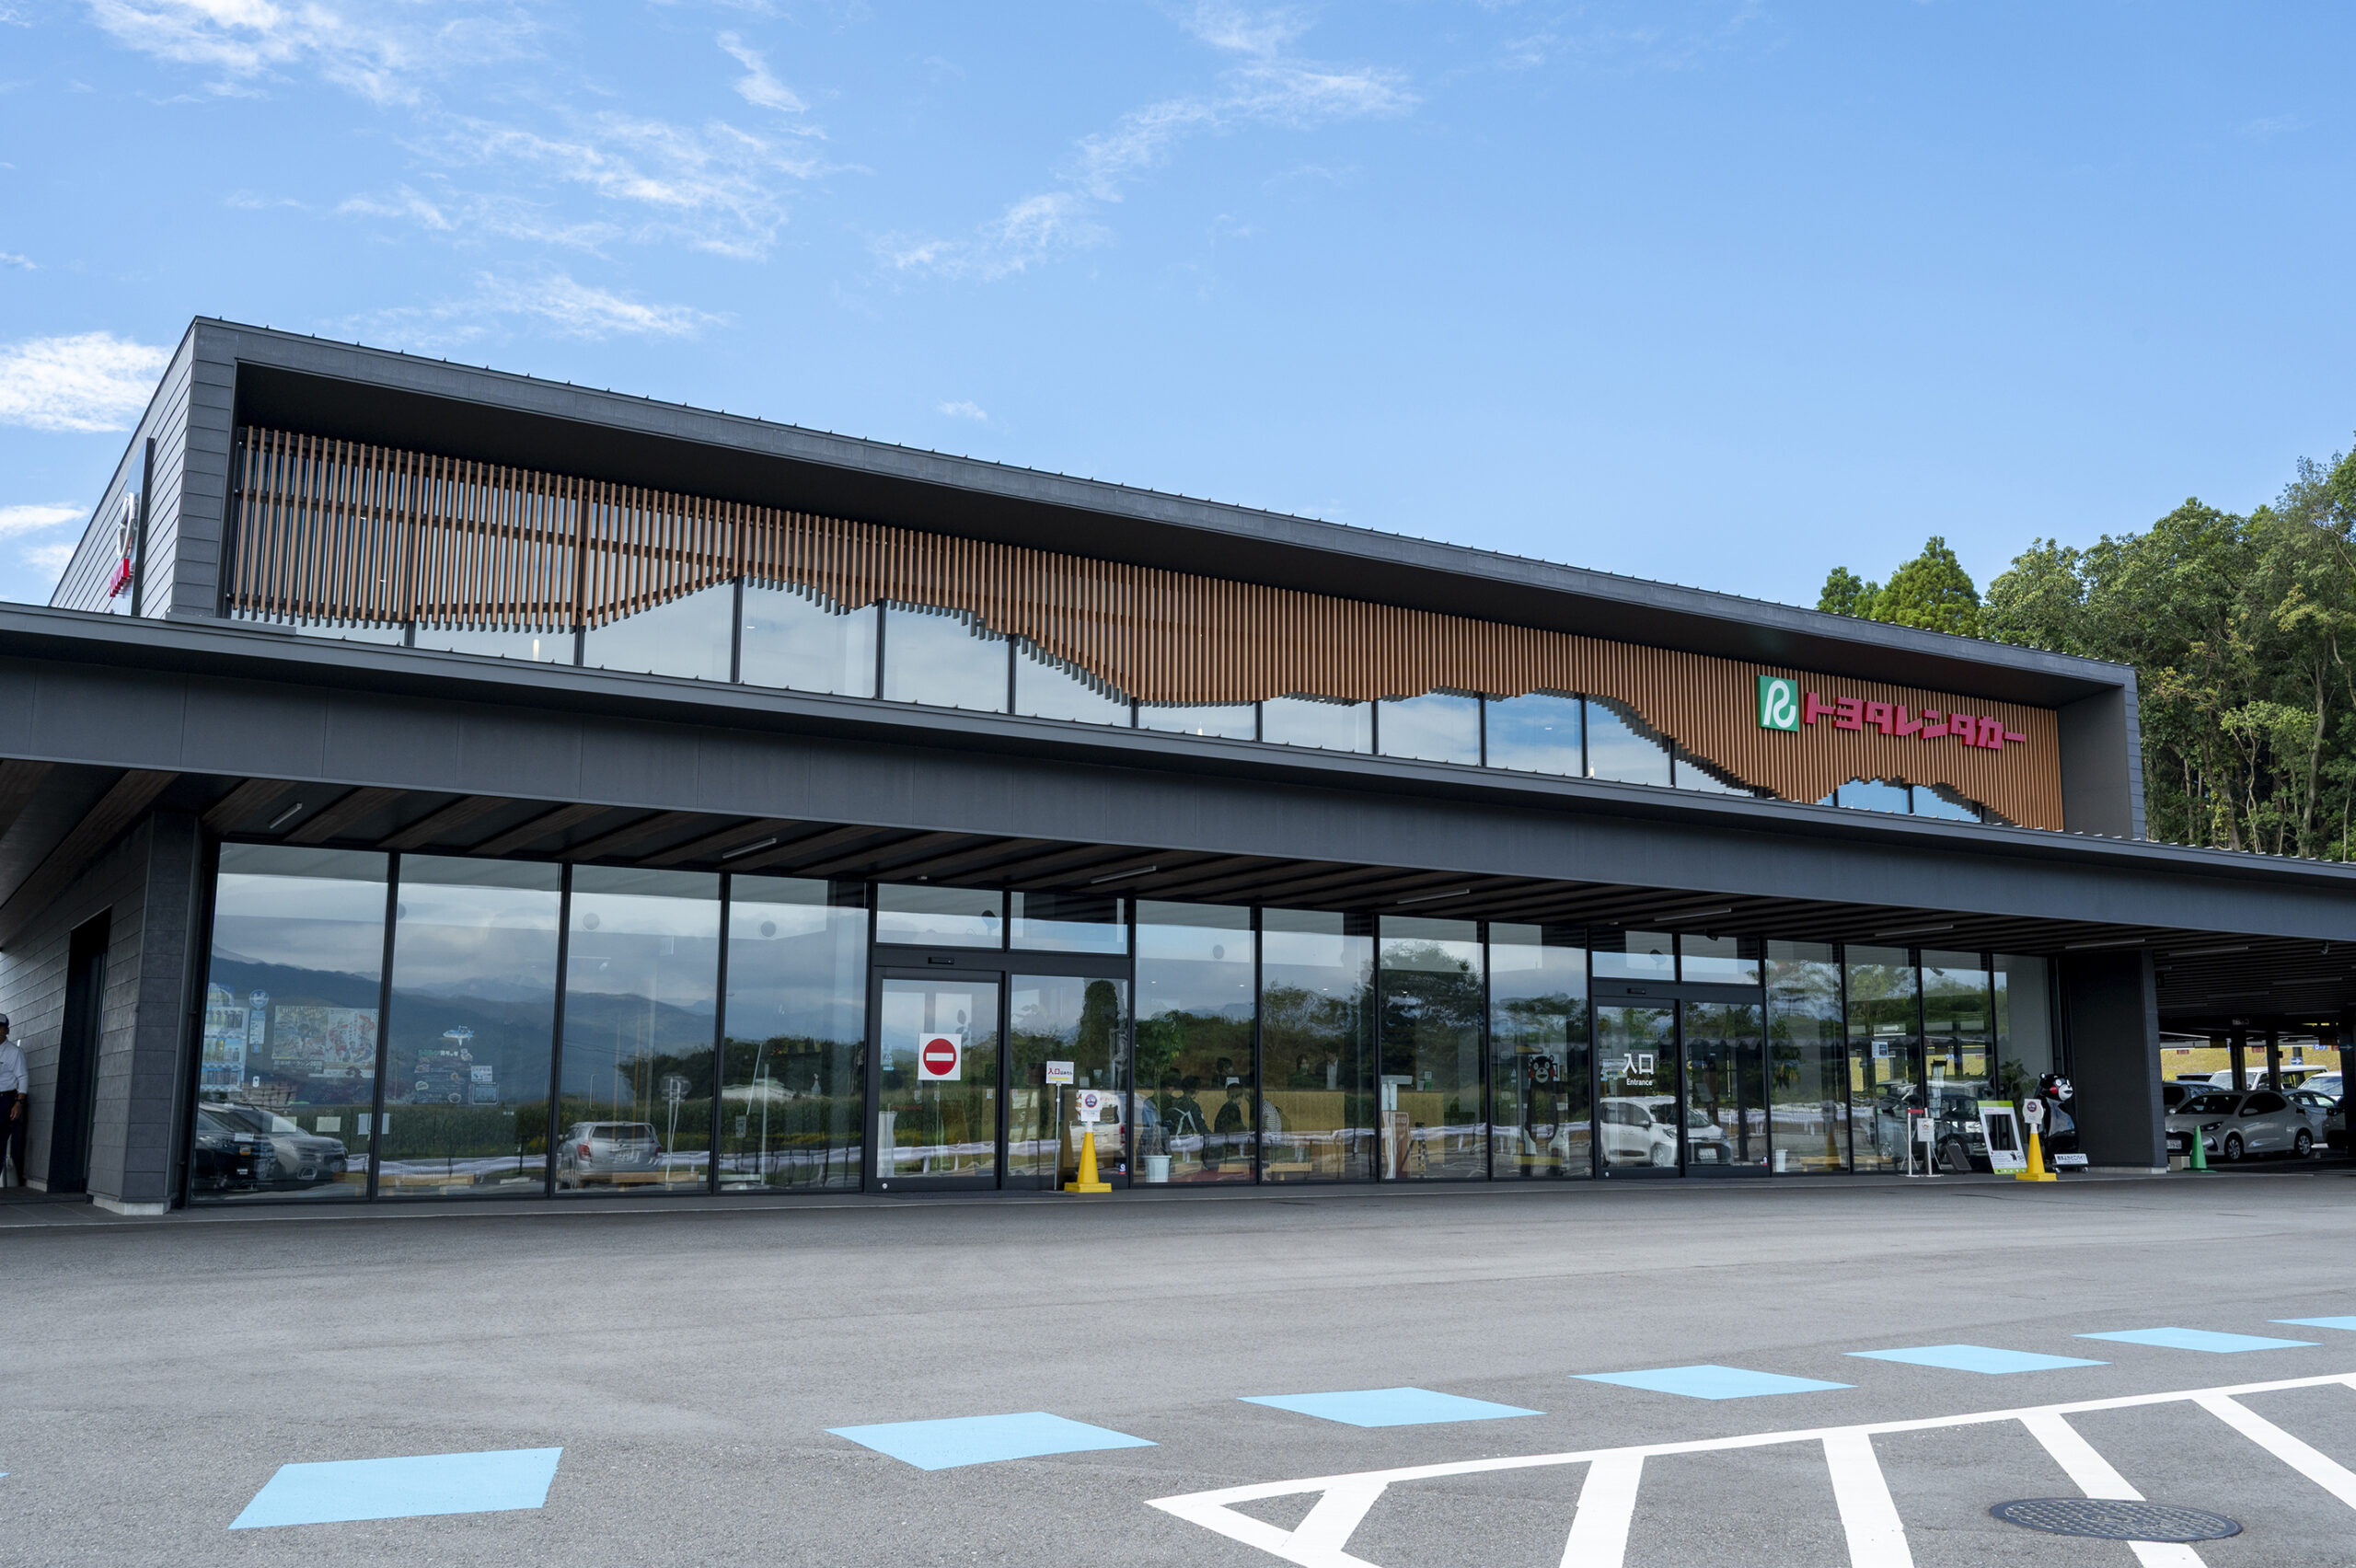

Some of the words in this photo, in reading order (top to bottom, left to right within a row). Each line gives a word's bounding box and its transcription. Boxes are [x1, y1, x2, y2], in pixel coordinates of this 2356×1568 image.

[1804, 692, 2026, 750] トヨタレンタカー
[1623, 1053, 1655, 1075] 入口
[1626, 1078, 1653, 1086] Entrance
